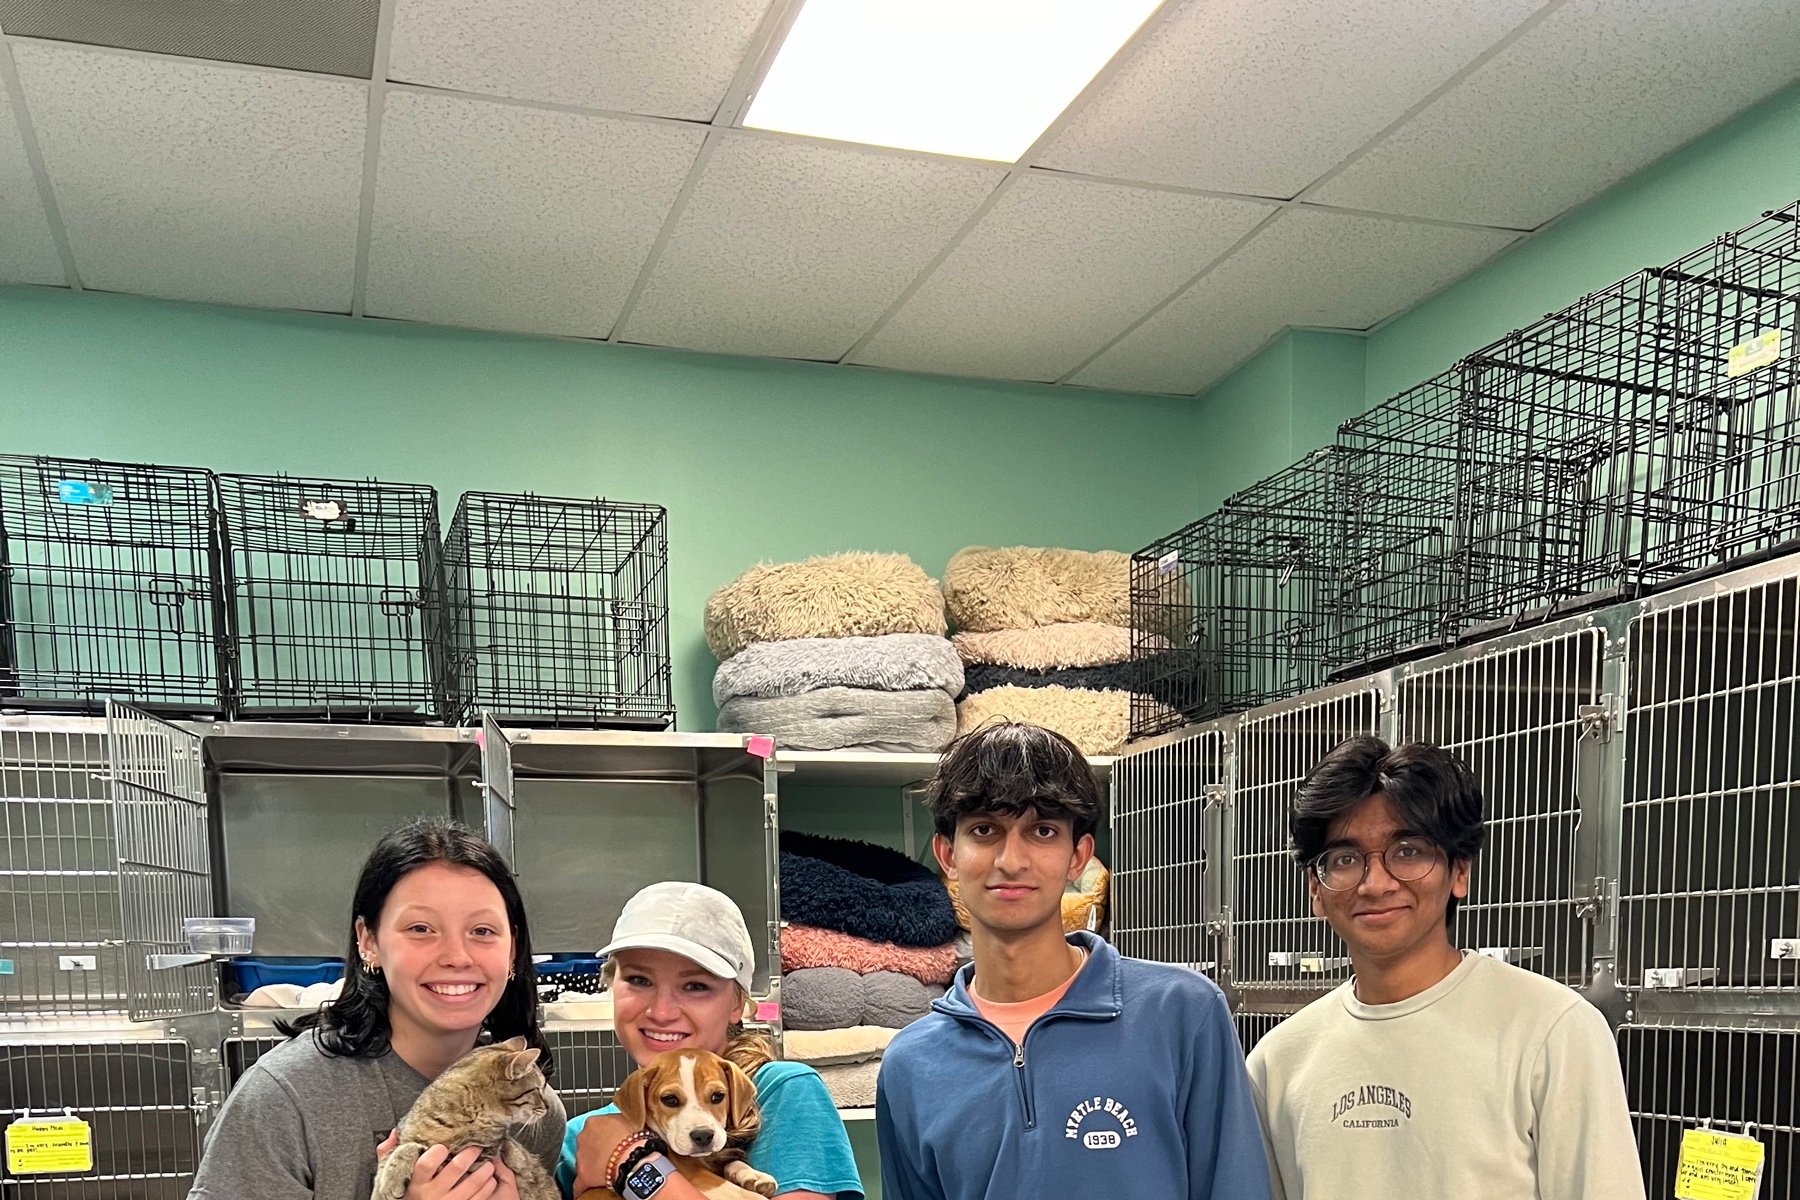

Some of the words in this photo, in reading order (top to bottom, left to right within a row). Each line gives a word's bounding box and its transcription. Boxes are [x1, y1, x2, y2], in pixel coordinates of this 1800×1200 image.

[1331, 1090, 1355, 1123] LOS
[1356, 1085, 1412, 1119] ANGELES
[1065, 1096, 1102, 1139] MYRTLE
[1103, 1097, 1138, 1138] BEACH
[1343, 1119, 1399, 1128] CALIFORNIA
[1087, 1134, 1116, 1146] 1938
